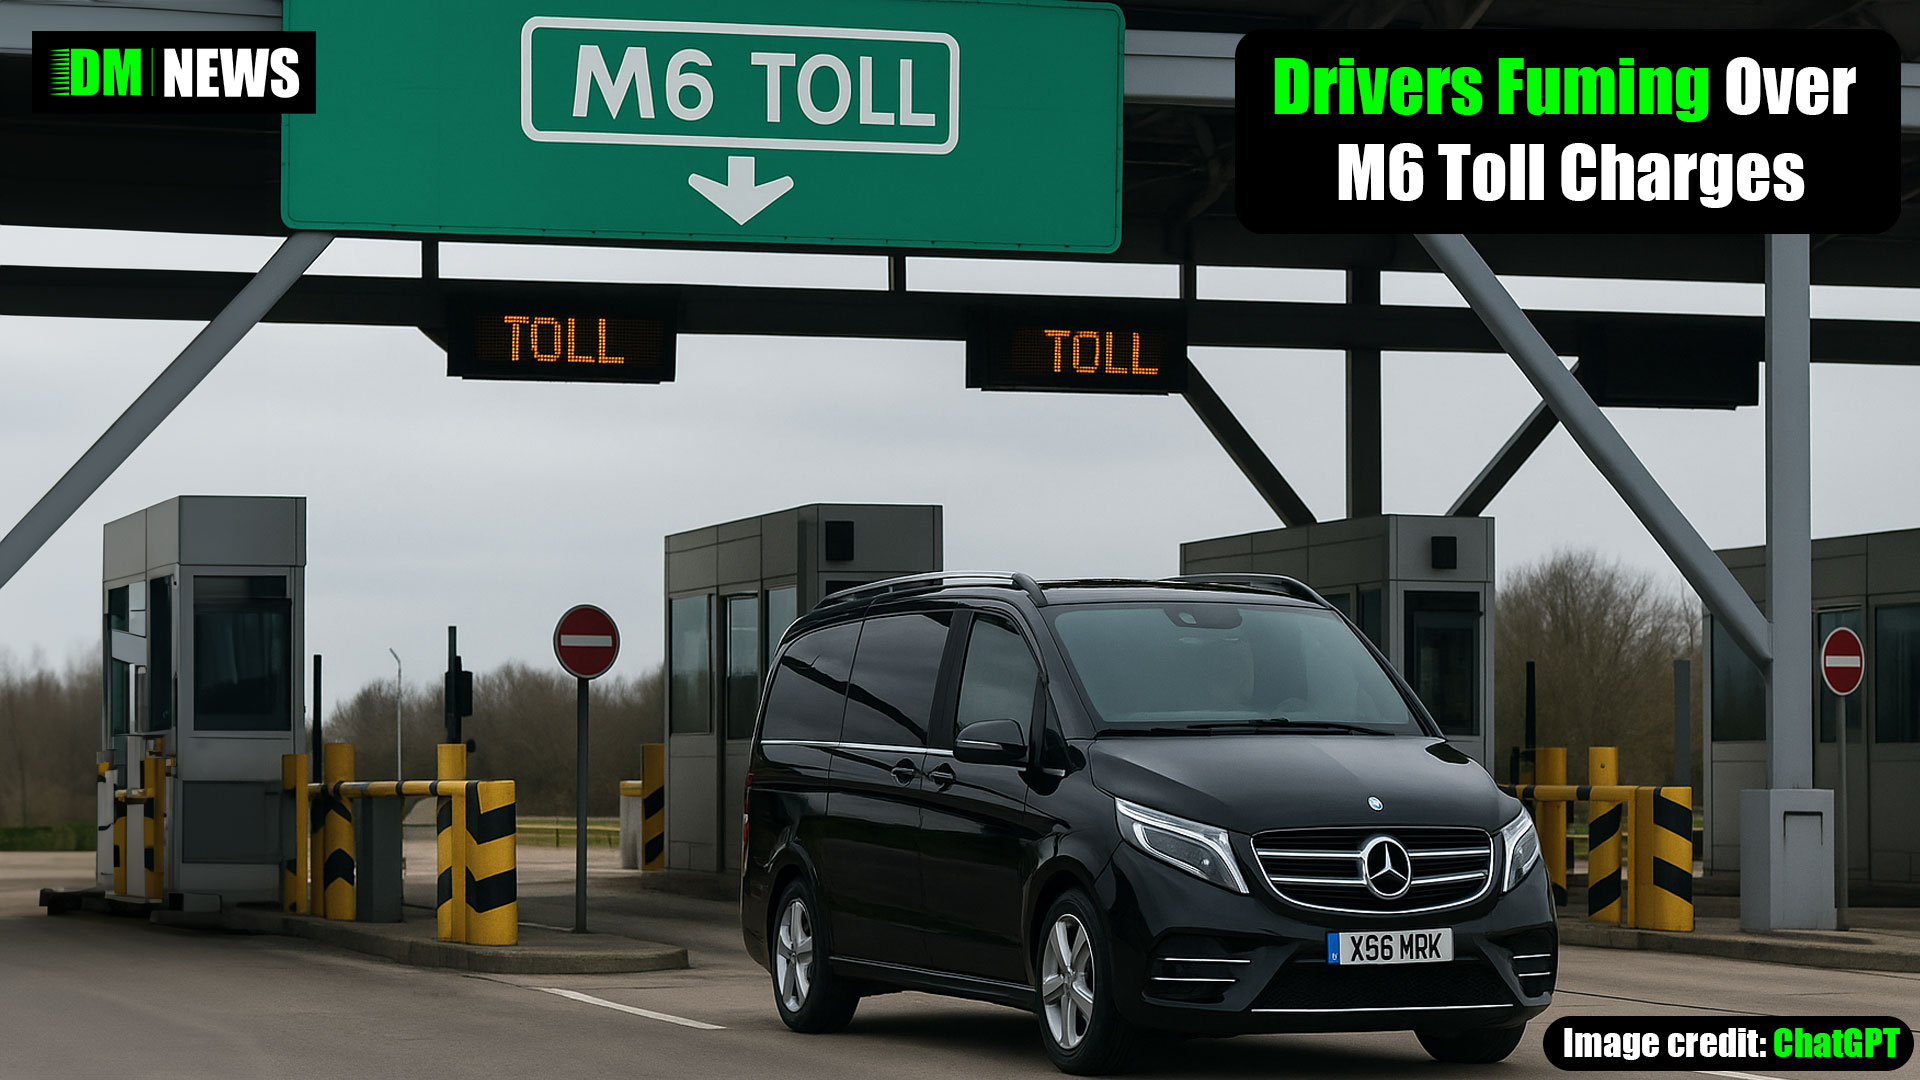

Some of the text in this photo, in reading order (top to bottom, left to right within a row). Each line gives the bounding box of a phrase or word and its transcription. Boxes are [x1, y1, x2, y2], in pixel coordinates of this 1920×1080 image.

[572, 44, 936, 127] M6 TOLL
[504, 315, 625, 364] TOLL
[1044, 329, 1159, 375] TOLL
[1399, 932, 1442, 960] MRK
